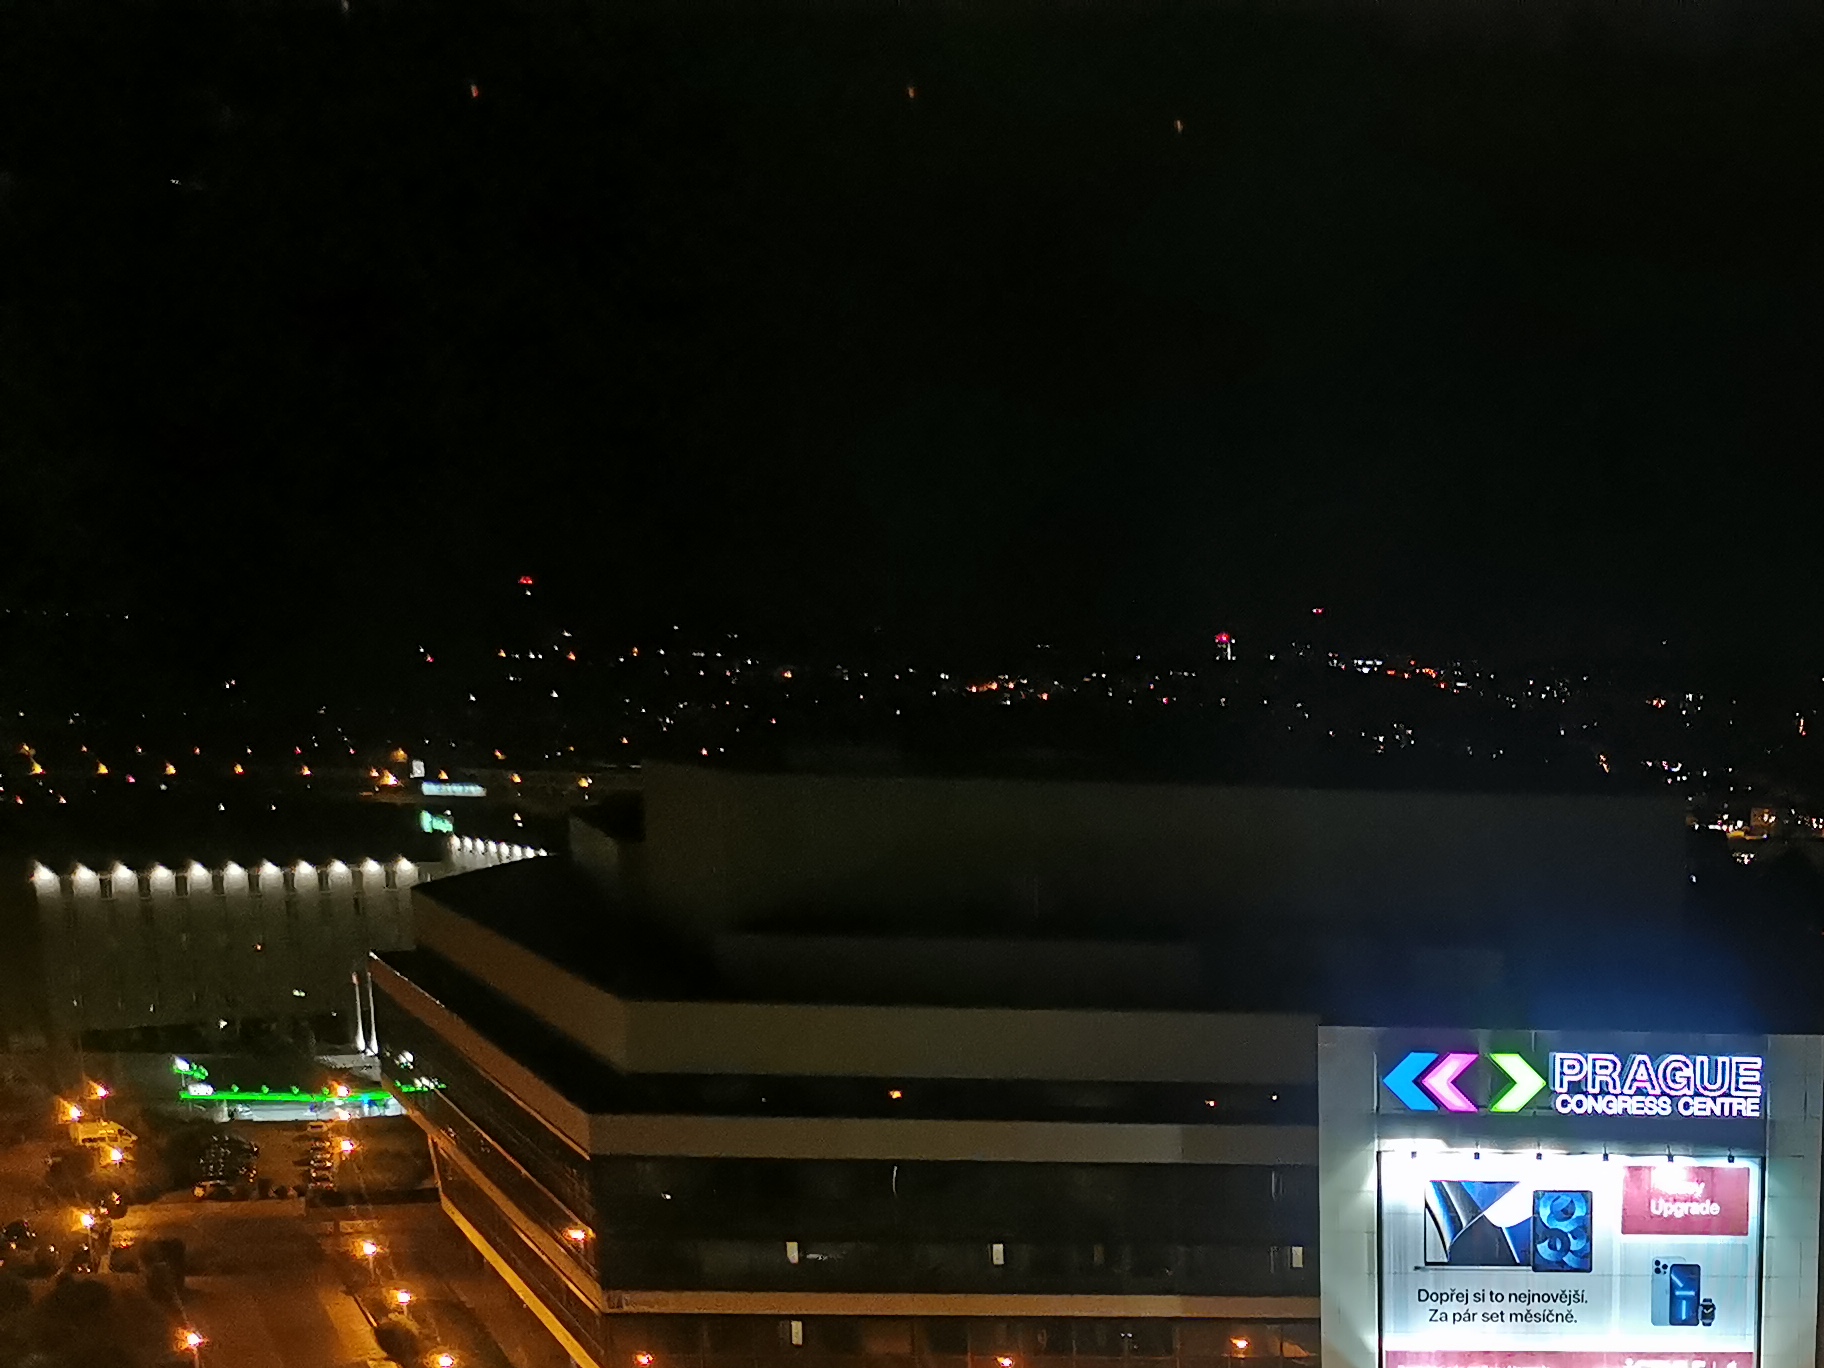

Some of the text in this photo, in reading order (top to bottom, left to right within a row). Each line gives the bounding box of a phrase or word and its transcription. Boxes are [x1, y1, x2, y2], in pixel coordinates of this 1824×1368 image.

[1550, 1051, 1763, 1097] PRAGUE
[1554, 1093, 1760, 1117] CONGRESS CENTRE
[1650, 1199, 1721, 1219] Upgrade
[1417, 1288, 1588, 1306] Dopřej si to nejnovější.
[1428, 1308, 1578, 1325] Za pár set měsíčně.
